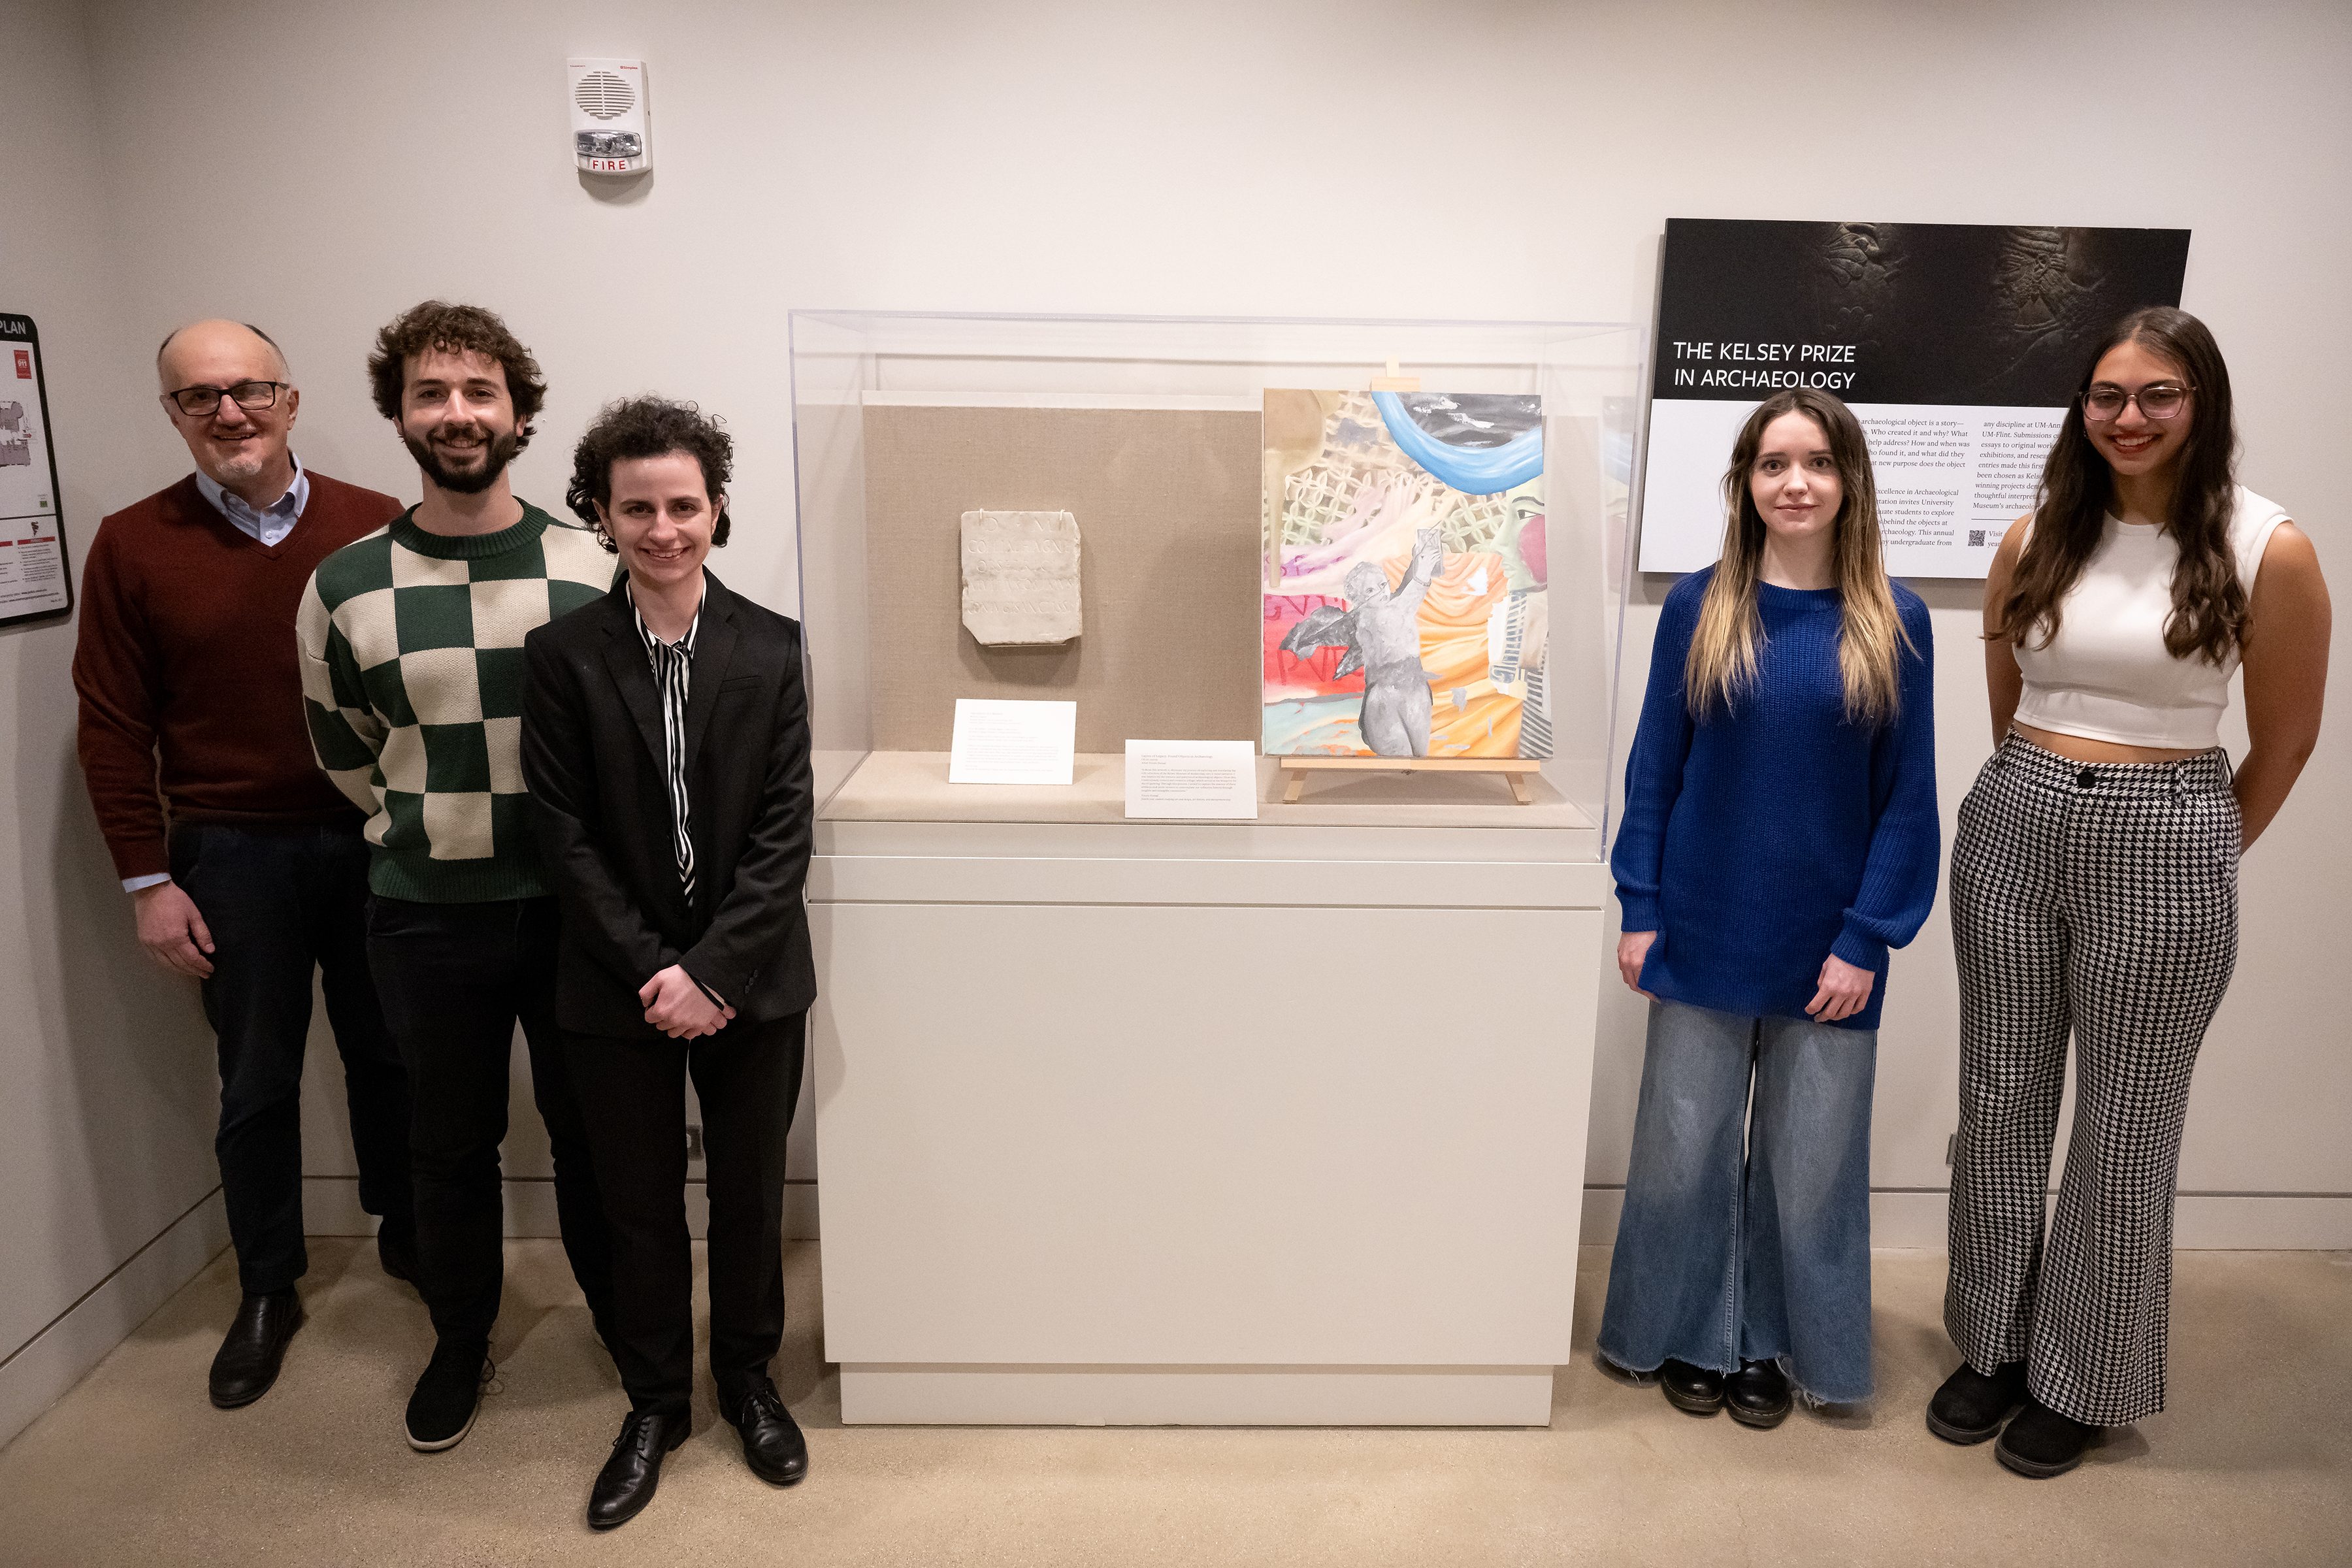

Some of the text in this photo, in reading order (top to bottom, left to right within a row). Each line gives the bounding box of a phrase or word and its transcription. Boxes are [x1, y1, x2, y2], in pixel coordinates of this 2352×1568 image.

[593, 160, 627, 171] FIRE
[1674, 342, 1855, 363] THE KELSEY PRIZE
[1674, 368, 1855, 389] IN ARCHAEOLOGY
[1861, 418, 1906, 427] archaeological
[1996, 421, 2025, 429] discipline
[1868, 438, 1882, 448] help
[1914, 489, 1959, 497] Archaeological
[1974, 492, 2006, 500] thoughtful
